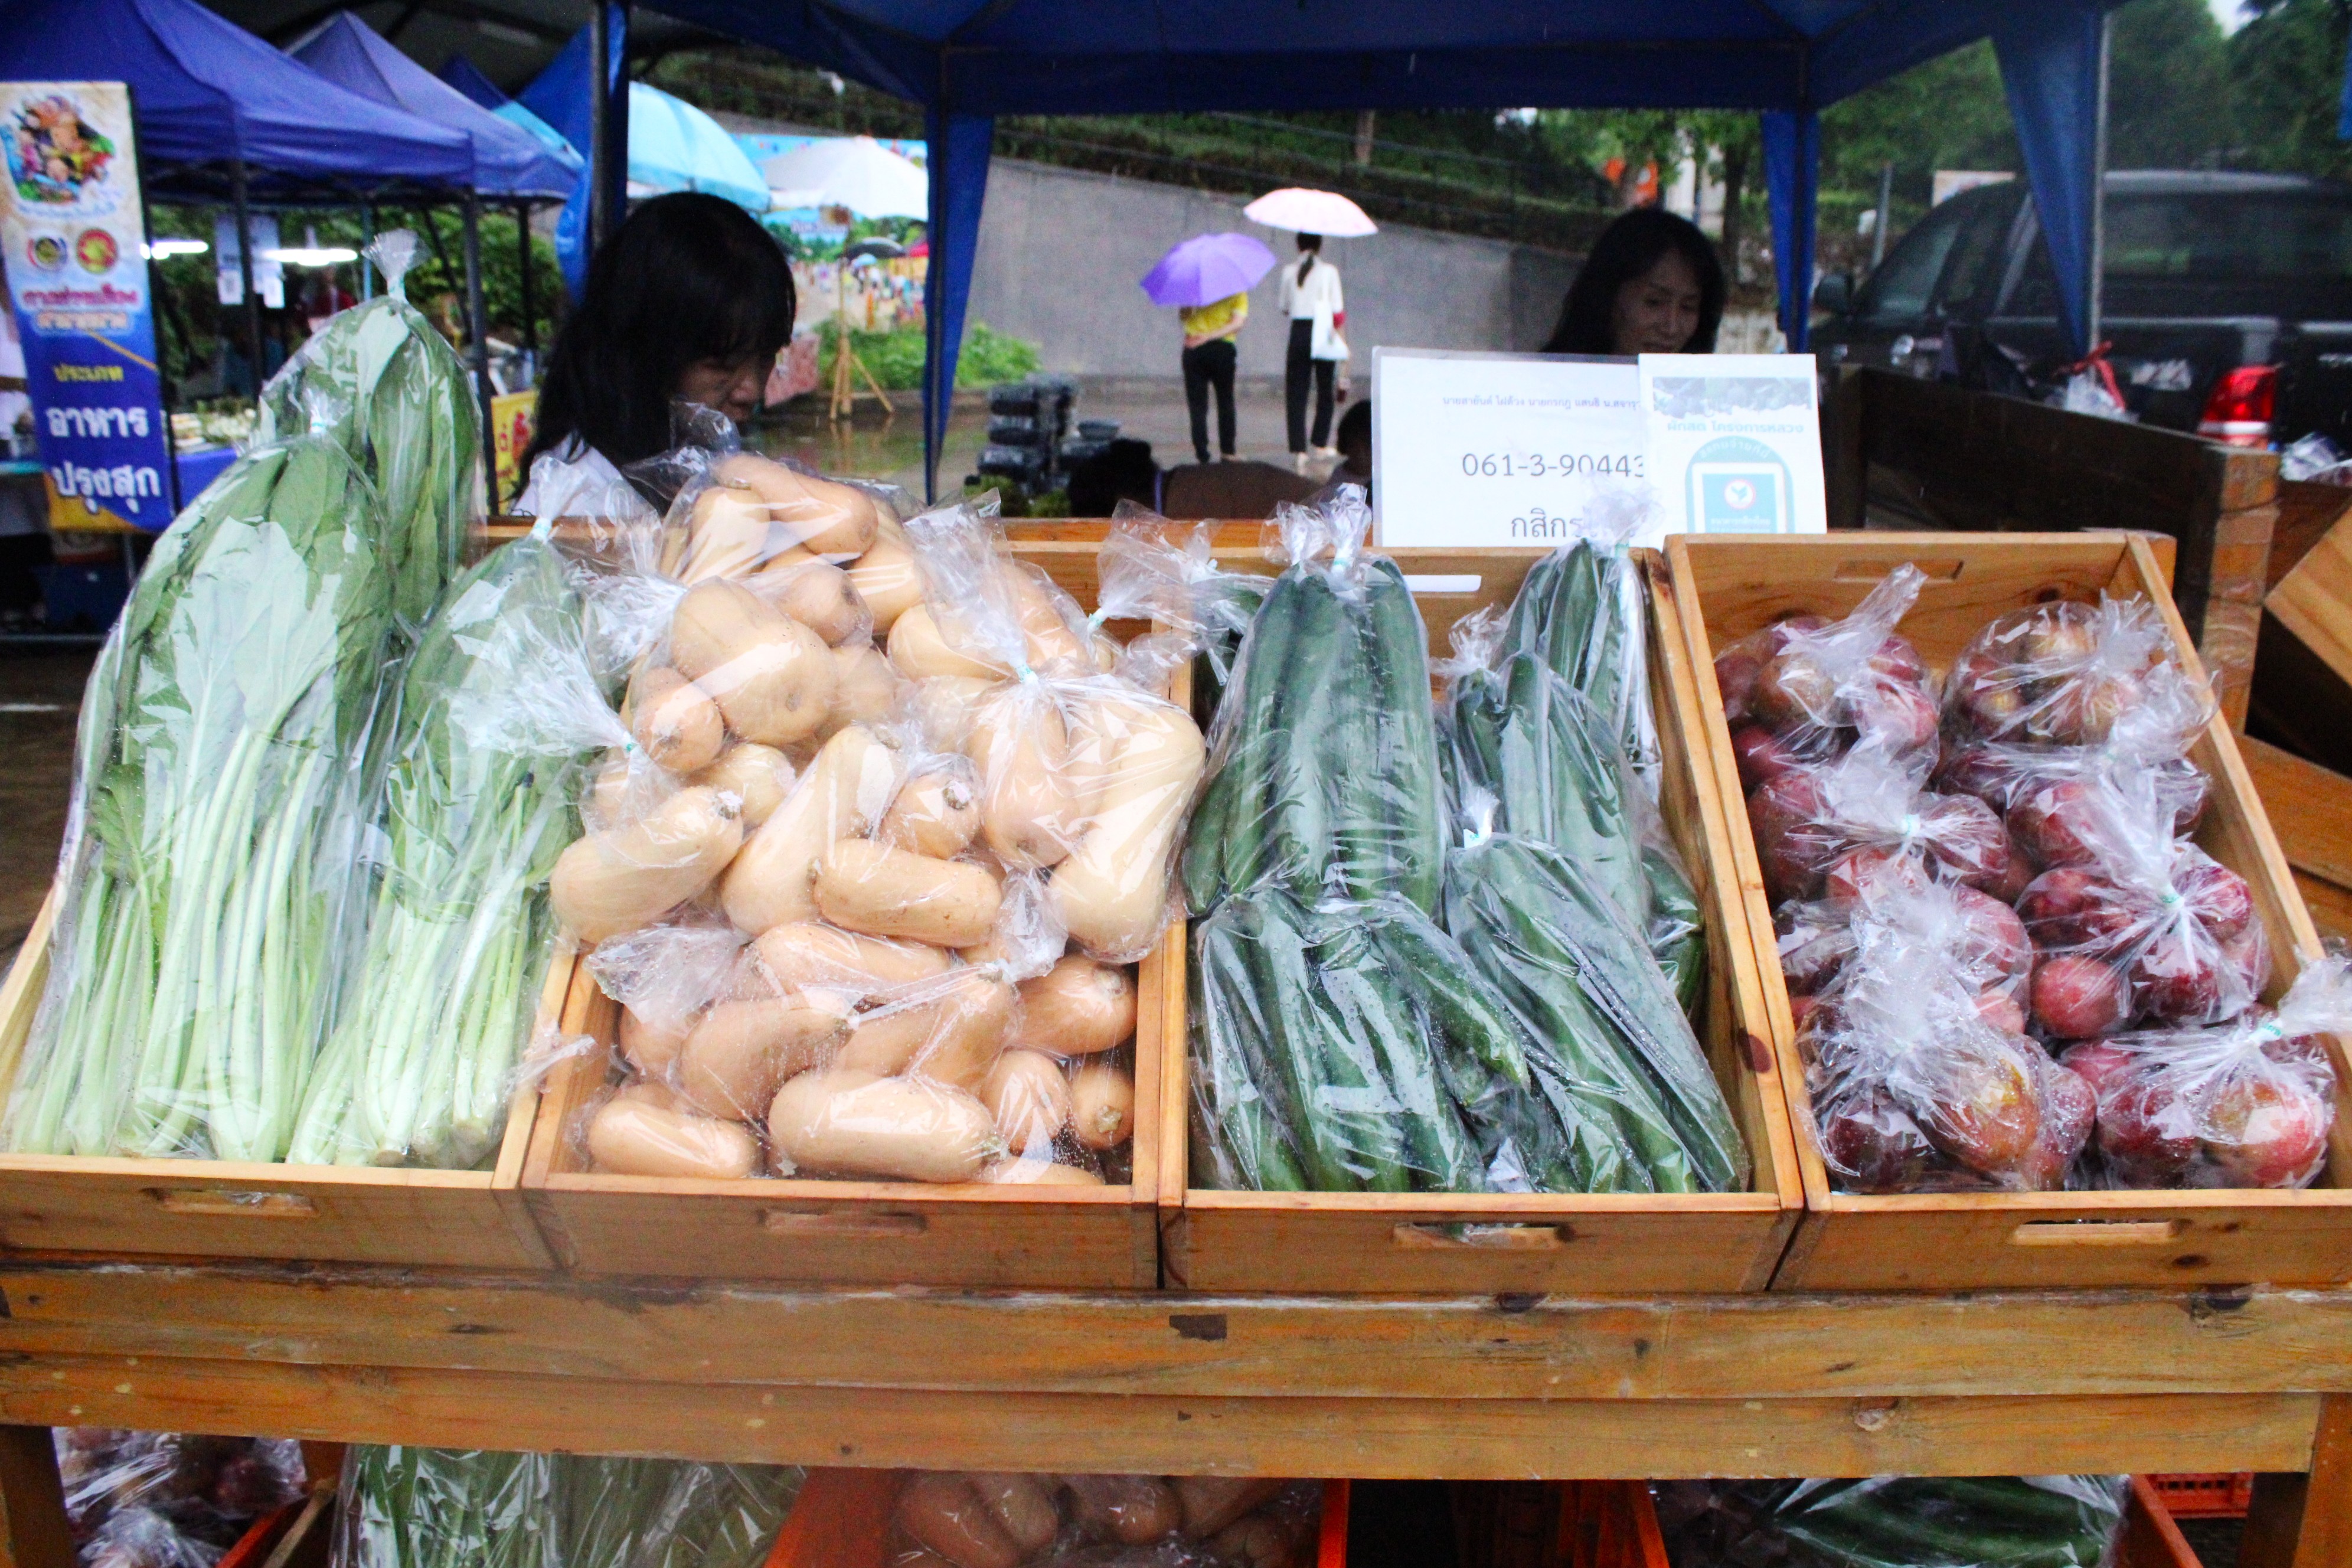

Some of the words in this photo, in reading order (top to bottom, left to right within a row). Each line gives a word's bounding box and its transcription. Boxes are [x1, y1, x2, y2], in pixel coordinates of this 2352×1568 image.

[46, 406, 150, 437] อาหาร
[52, 460, 161, 514] ปรุงสุก
